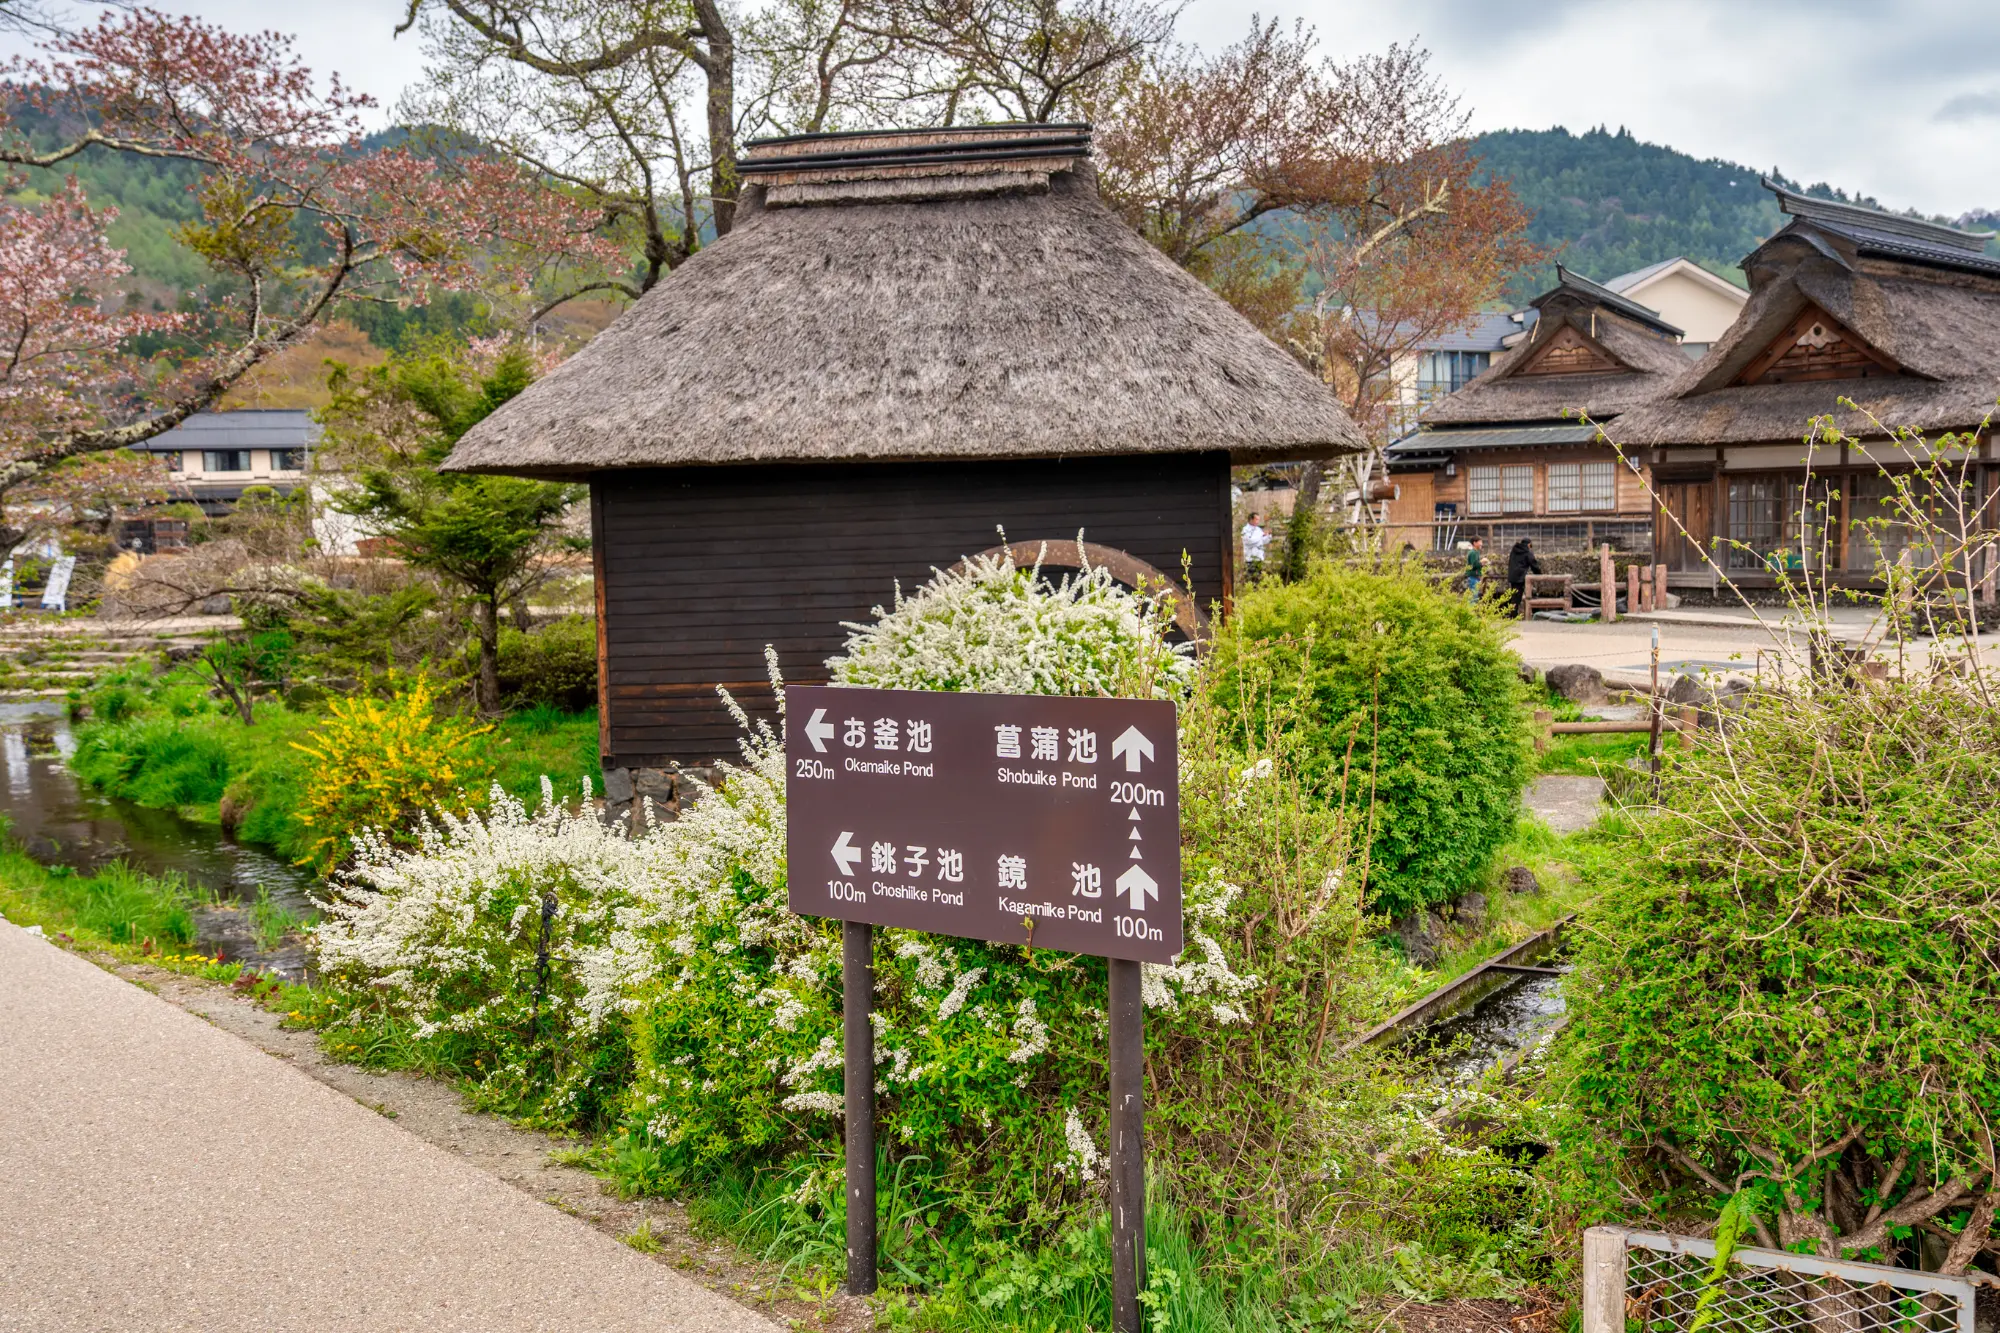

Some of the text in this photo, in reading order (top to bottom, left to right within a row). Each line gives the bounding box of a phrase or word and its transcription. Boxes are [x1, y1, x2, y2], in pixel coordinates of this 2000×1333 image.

[843, 716, 933, 753] お釜池
[994, 723, 1098, 764] 菖蒲池
[796, 758, 835, 780] 250m
[844, 757, 934, 778] Okamaike Pond
[997, 767, 1097, 790] Shobuike Pond
[1110, 781, 1165, 807] 200m
[870, 840, 964, 883] 銚子池
[827, 879, 867, 904] 100m
[871, 881, 964, 906] Choshiike Pond
[998, 896, 1103, 924] Kagamiike Pond
[1113, 915, 1163, 942] 100m
